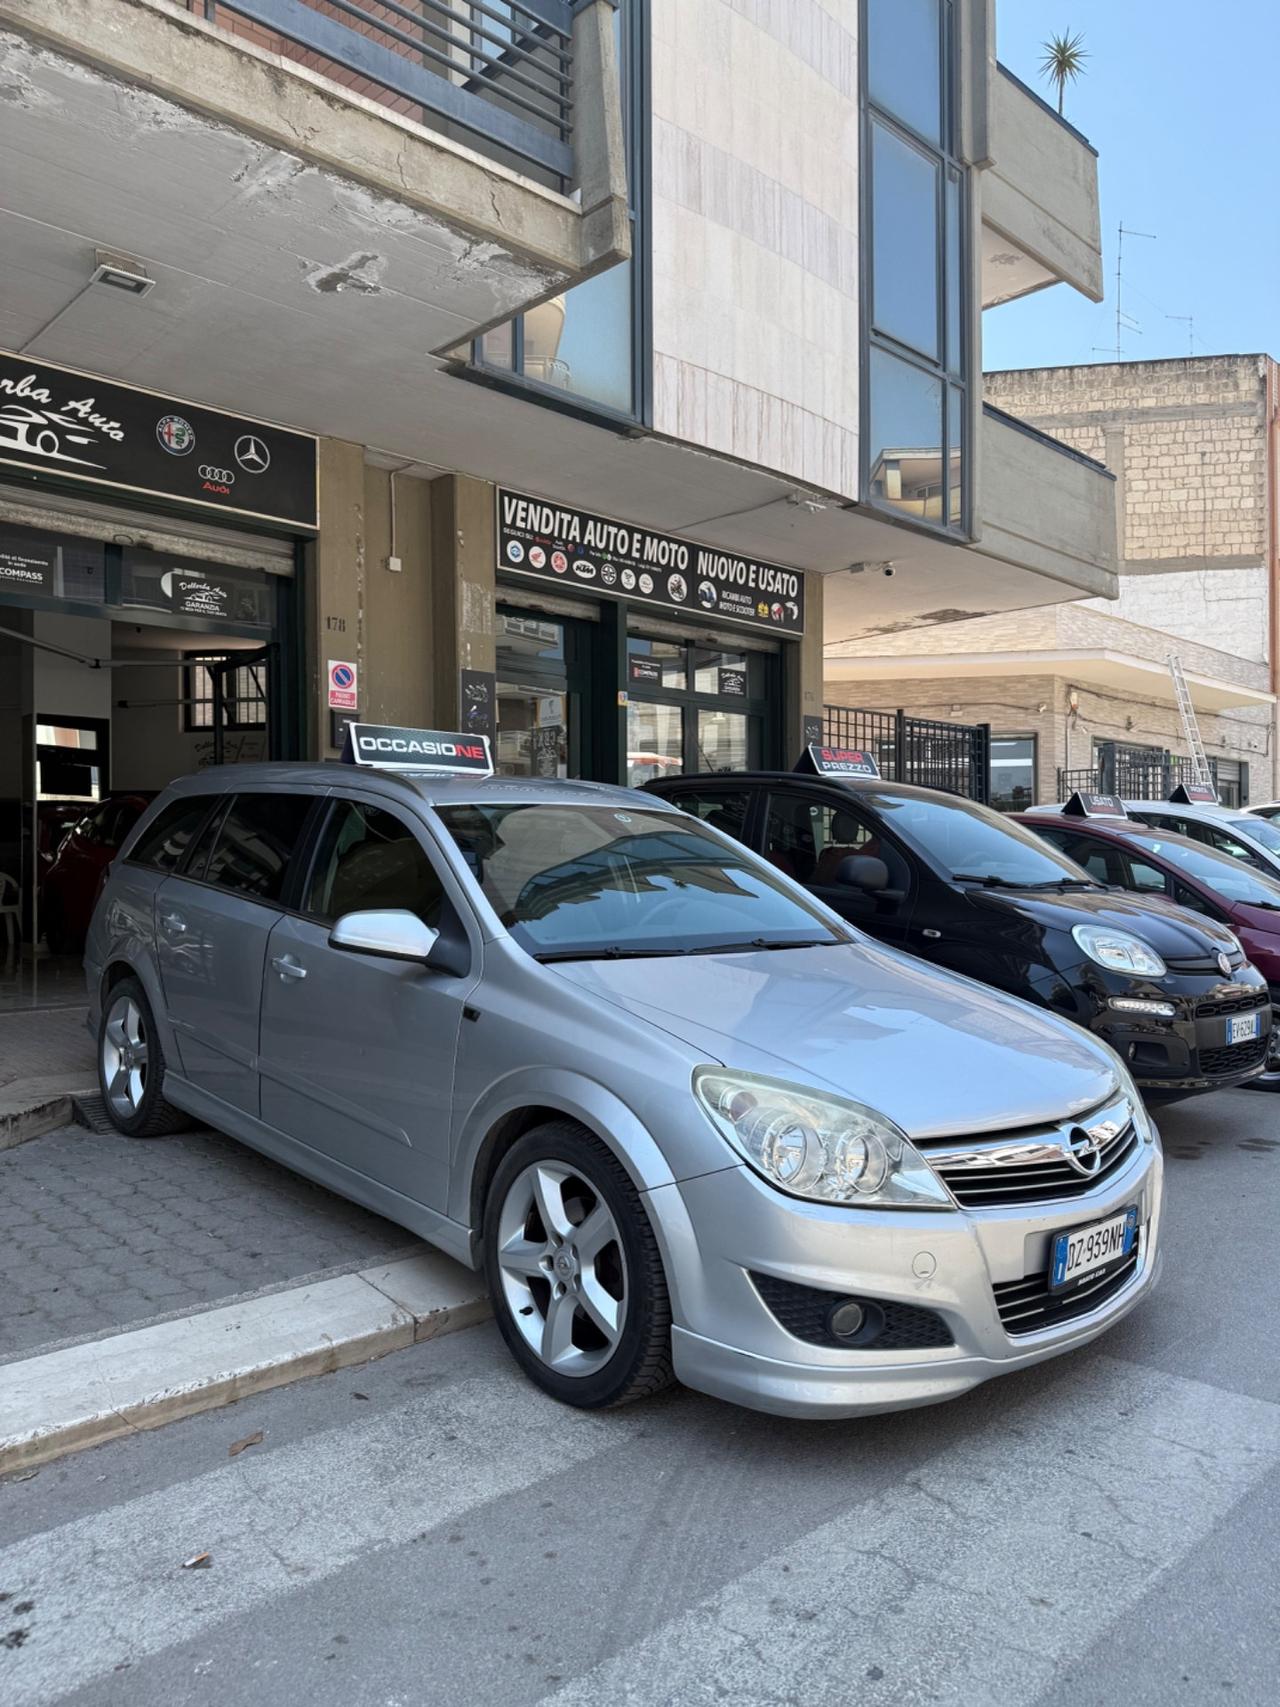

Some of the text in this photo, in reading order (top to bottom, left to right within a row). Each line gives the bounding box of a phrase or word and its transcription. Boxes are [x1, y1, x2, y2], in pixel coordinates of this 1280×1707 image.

[60, 398, 125, 442] Auto
[202, 481, 231, 495] Audi
[503, 496, 689, 571] VENDITA AUTO E MOTO
[0, 567, 43, 581] COMPASS
[575, 564, 594, 575] KTM
[697, 550, 799, 598] NUOVO E USATO
[359, 737, 485, 759] OCCASIONE
[821, 749, 864, 763] SUPER
[822, 761, 872, 773] PREZZO
